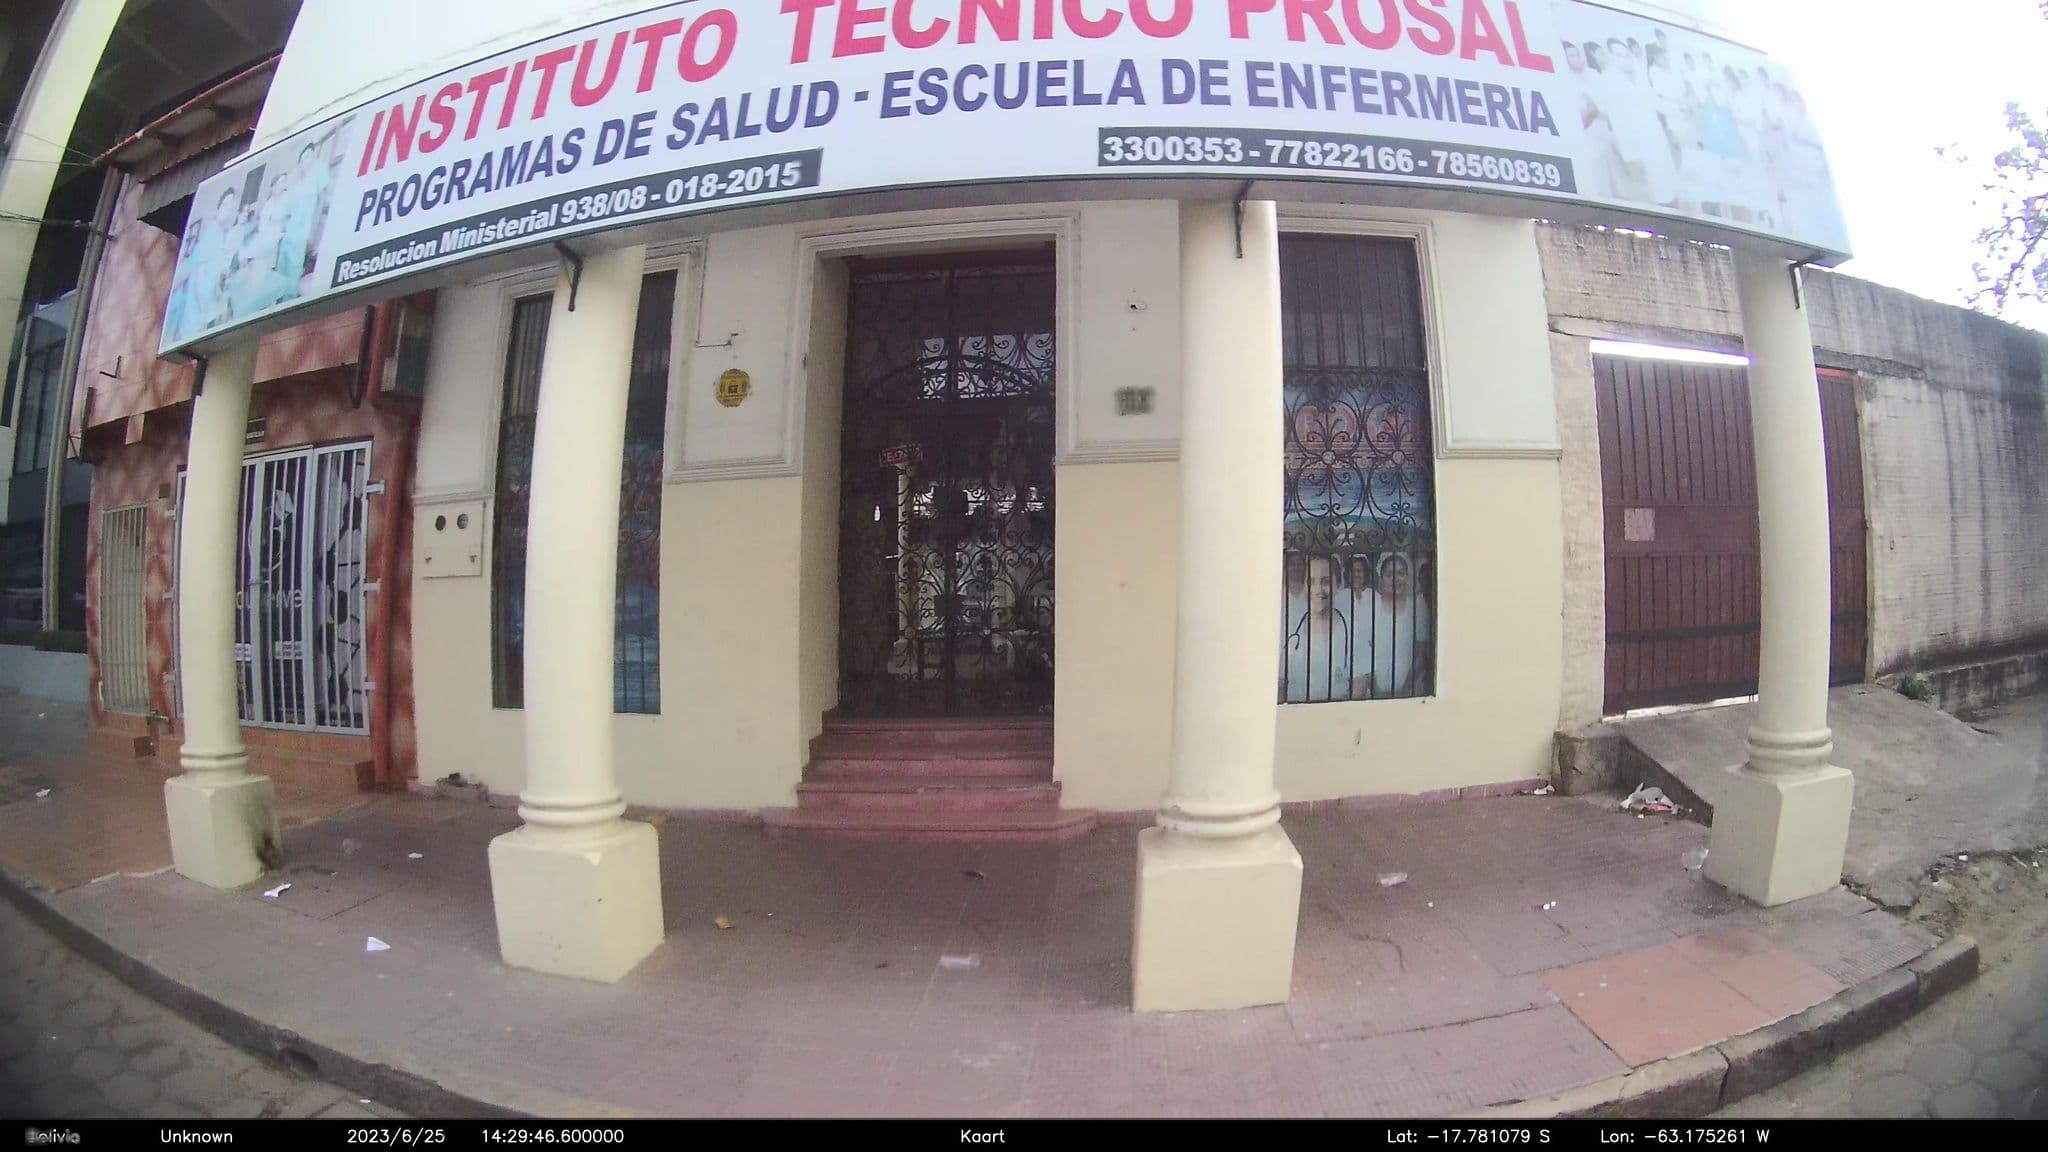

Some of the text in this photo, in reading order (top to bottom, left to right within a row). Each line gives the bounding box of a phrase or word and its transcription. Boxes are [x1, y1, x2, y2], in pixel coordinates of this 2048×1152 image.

[355, 134, 584, 233] PROGRAMAS
[593, 112, 656, 166] DE
[666, 80, 840, 150] SALUD
[880, 58, 1147, 119] ESCUELA
[1161, 58, 1232, 106] DE
[1244, 60, 1561, 137] ENFERMERIA
[357, 0, 1556, 177] INSTITUTO TECNICO PROSAL
[1103, 135, 1244, 164] 3300353
[1267, 138, 1414, 174] 77822166
[1433, 150, 1561, 188] 78560839
[337, 239, 438, 283] Resolucion
[439, 203, 558, 254] Ministerial
[561, 185, 648, 224] 938/08
[665, 159, 803, 204] 018-2015
